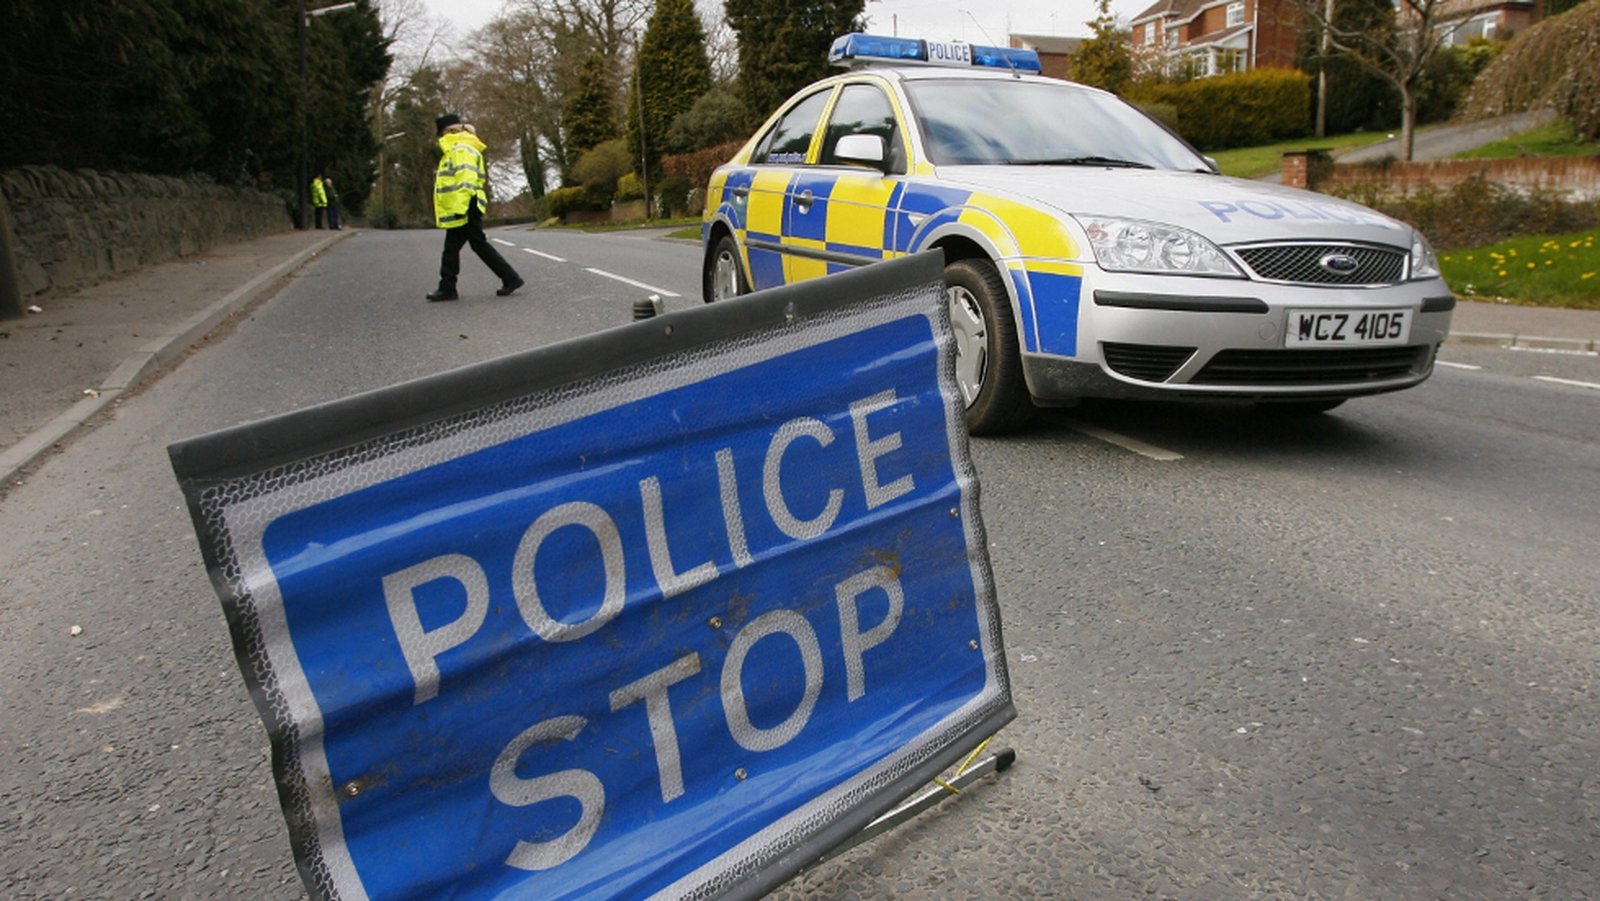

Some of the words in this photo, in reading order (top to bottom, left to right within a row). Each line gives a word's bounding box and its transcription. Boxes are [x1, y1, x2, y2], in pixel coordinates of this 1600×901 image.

[929, 43, 970, 62] POLICE
[1299, 314, 1349, 341] WCZ
[1354, 312, 1404, 340] 4105
[382, 388, 916, 706] POLICE
[489, 564, 905, 871] STOP
